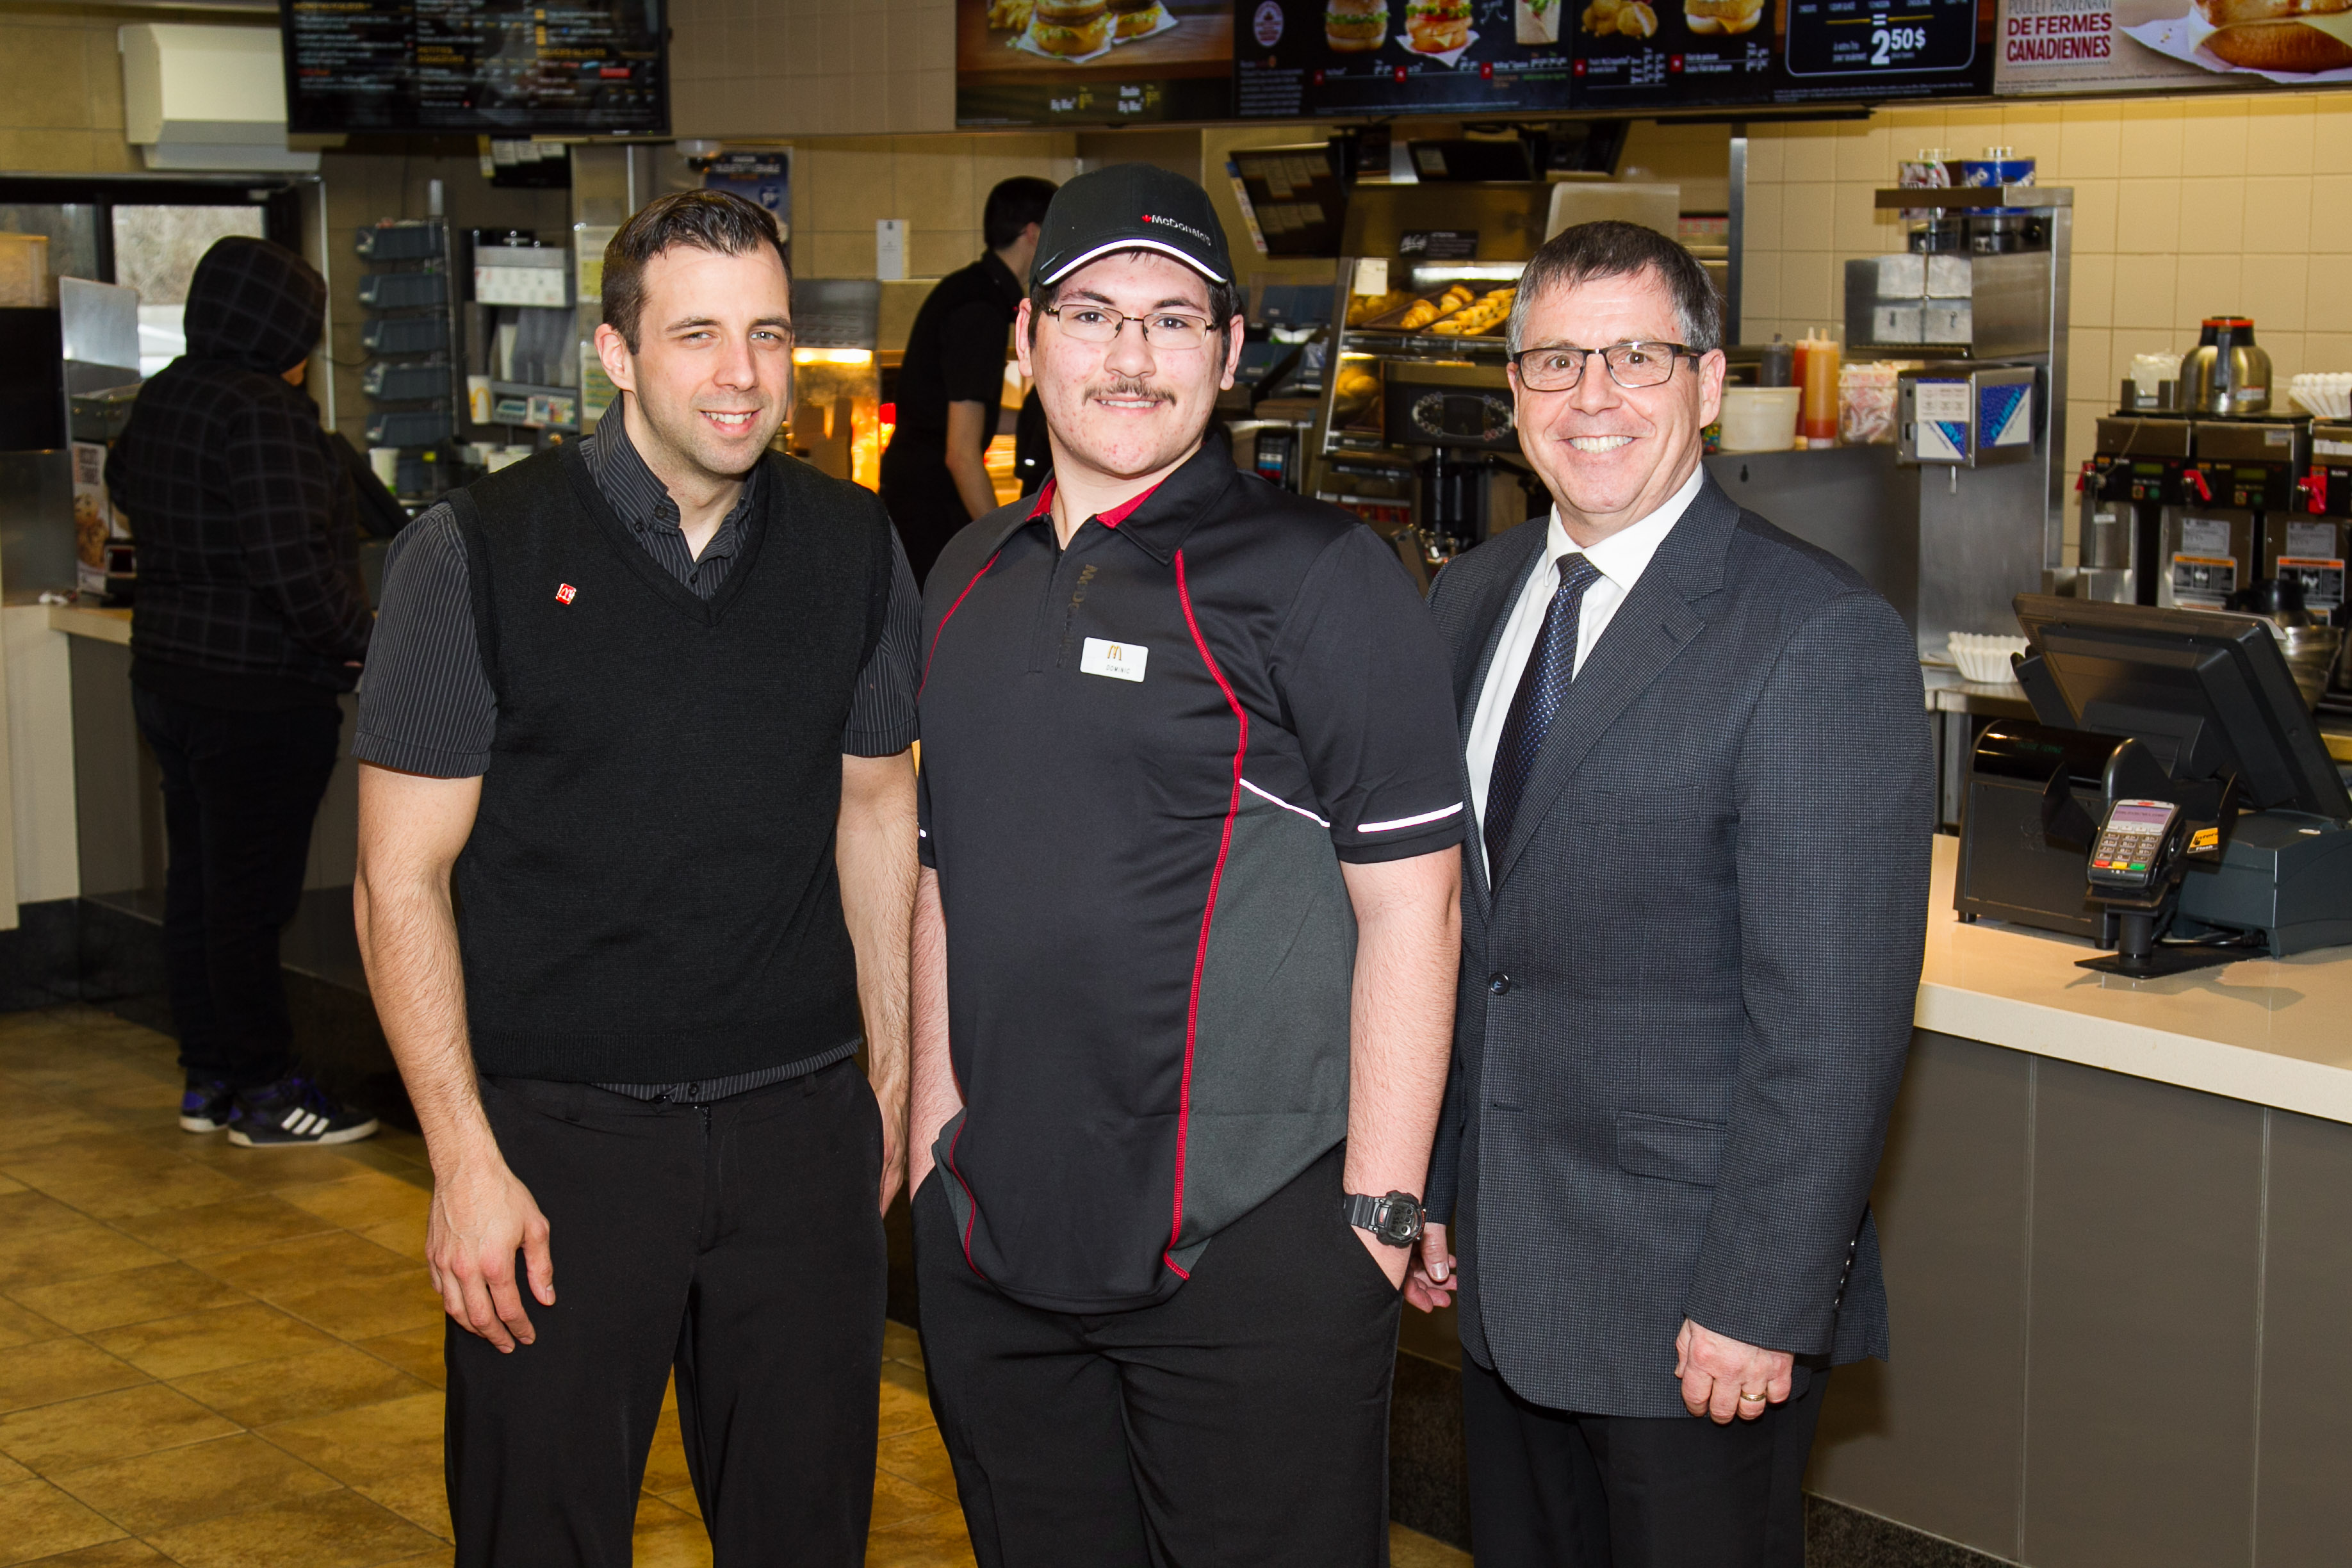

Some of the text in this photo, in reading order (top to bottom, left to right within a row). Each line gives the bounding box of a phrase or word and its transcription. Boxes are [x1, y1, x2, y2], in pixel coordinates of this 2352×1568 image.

[2008, 13, 2112, 36] DE FERMES
[2007, 35, 2111, 61] CANADIENNES
[1152, 215, 1211, 247] McDonald's
[1106, 664, 1131, 674] DOMINIC
